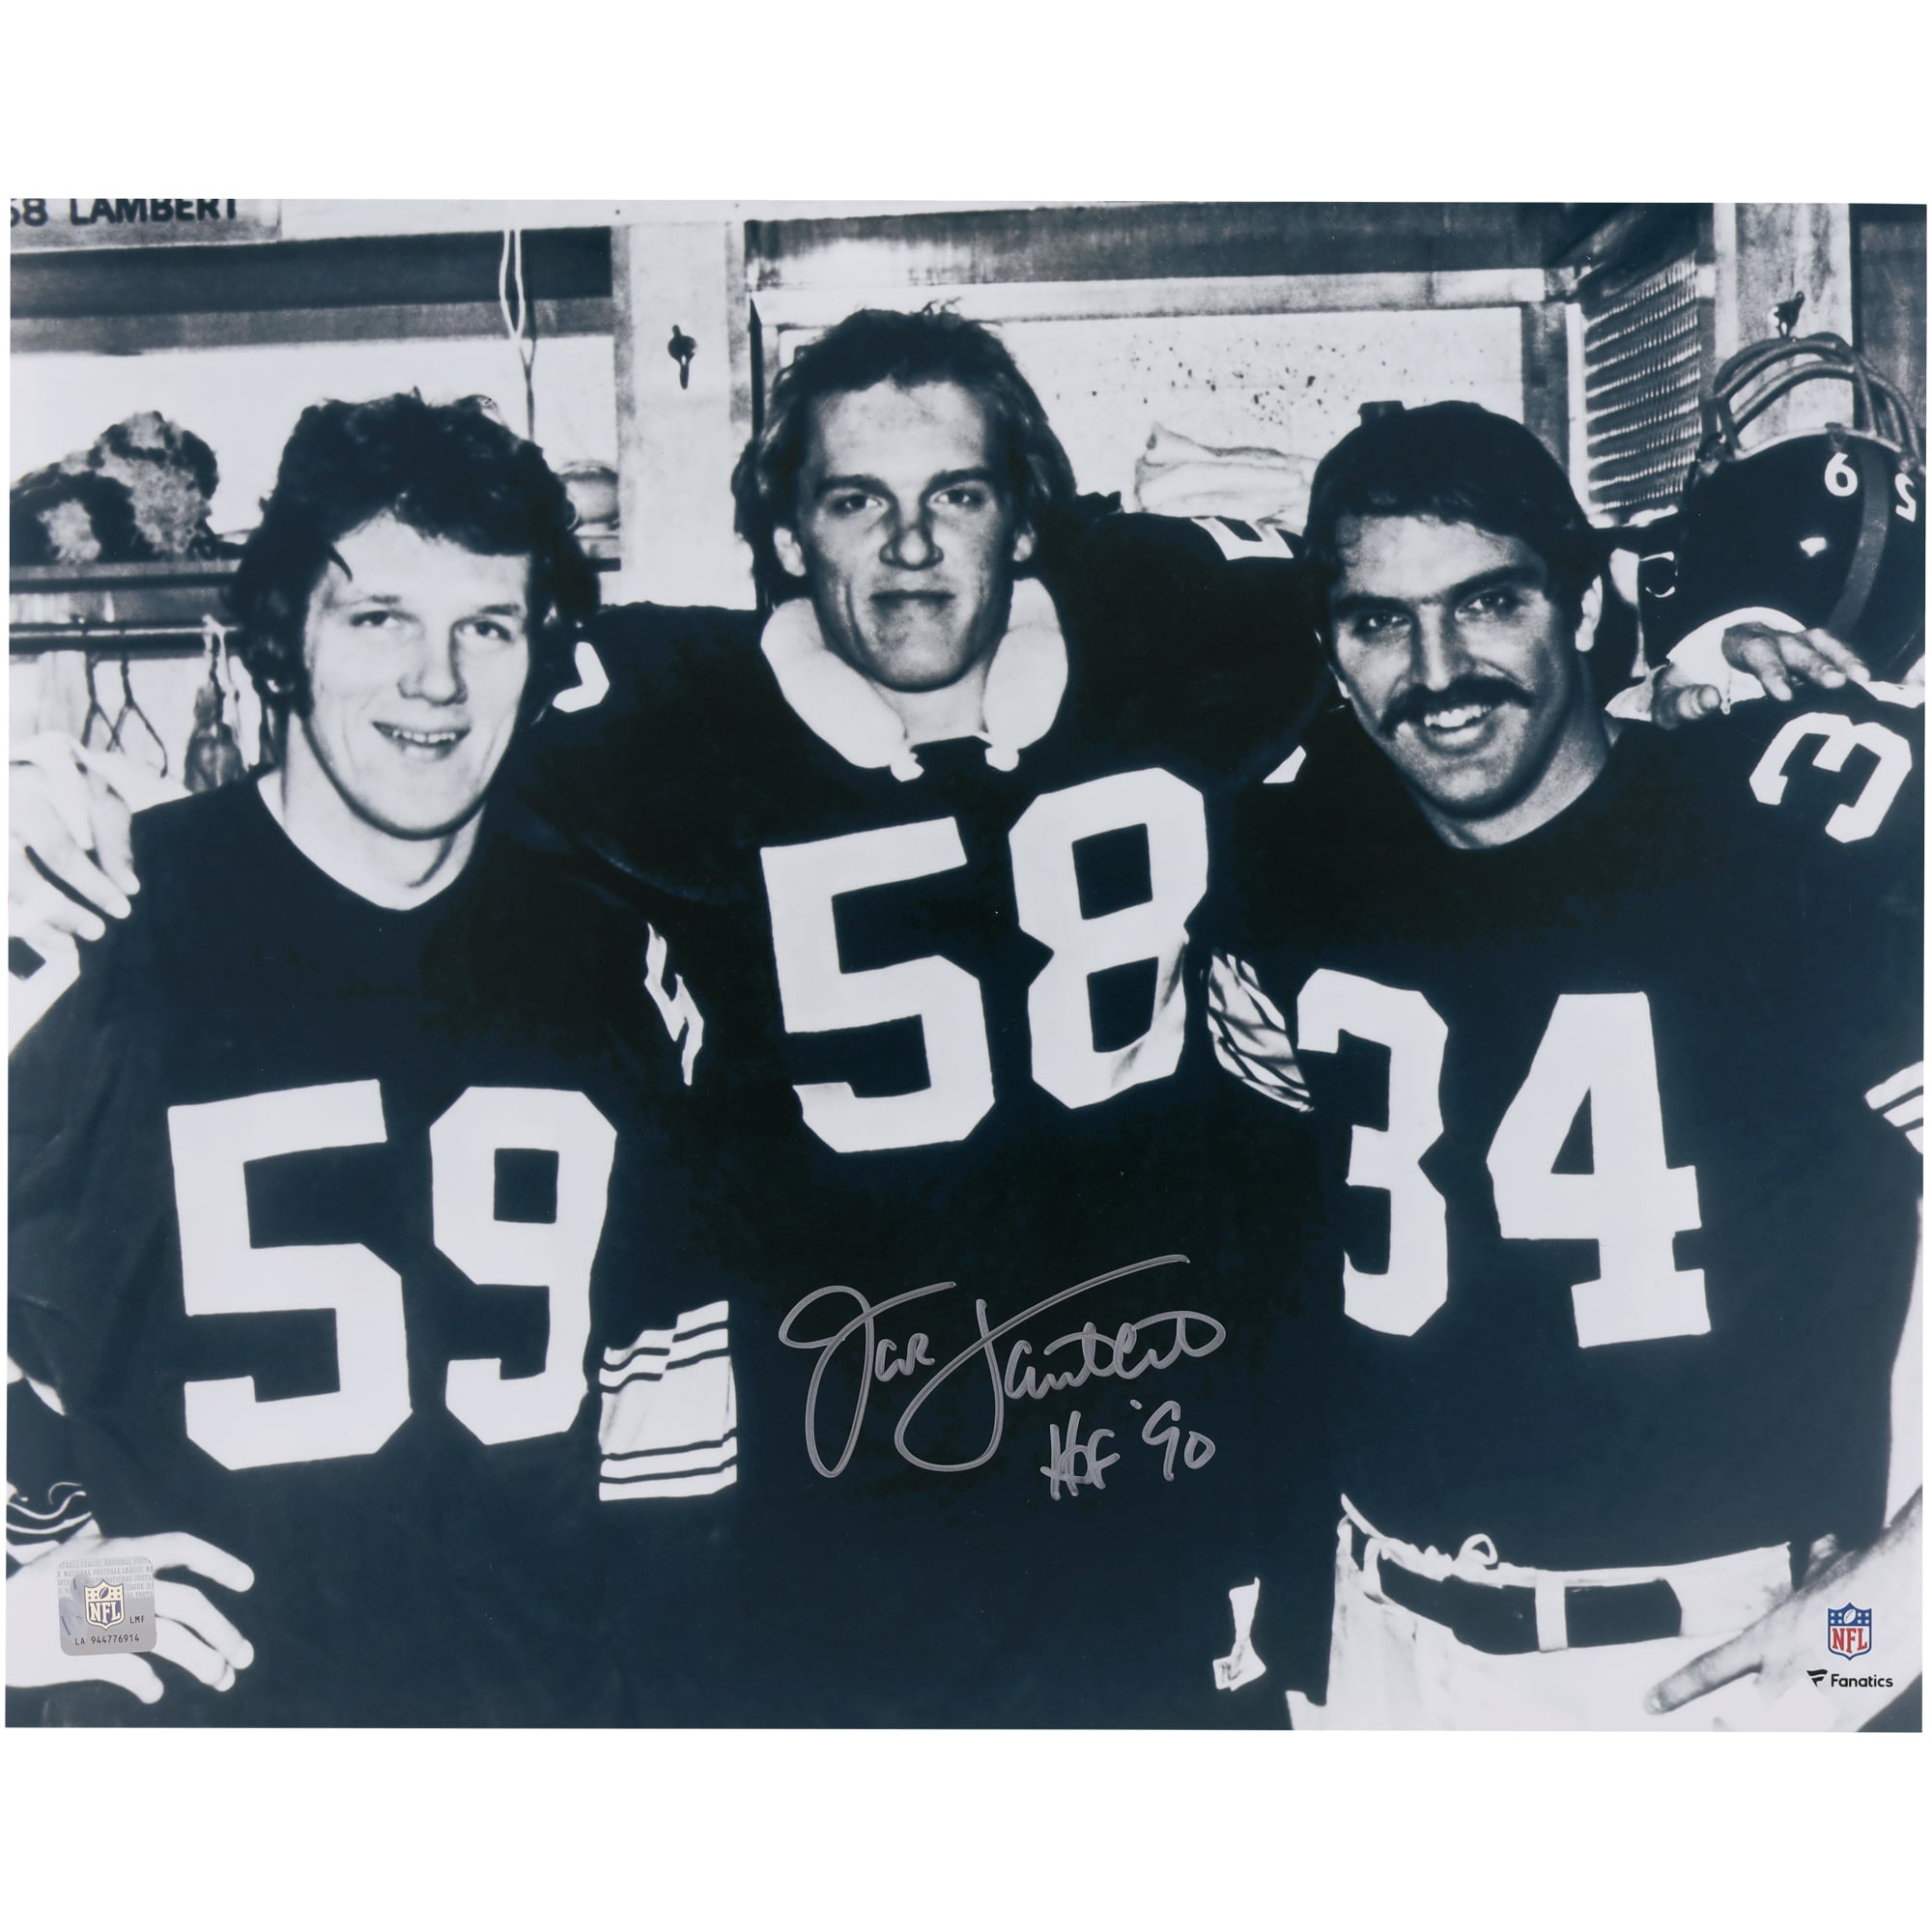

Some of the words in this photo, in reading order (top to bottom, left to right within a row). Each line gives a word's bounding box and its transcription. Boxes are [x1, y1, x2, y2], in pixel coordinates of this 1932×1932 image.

[760, 767, 1208, 1152] 58
[1297, 968, 1711, 1349] 34
[167, 1079, 617, 1470] 59
[89, 1602, 121, 1624] NFL
[91, 1634, 139, 1644] 944776914
[129, 1615, 146, 1624] LMF
